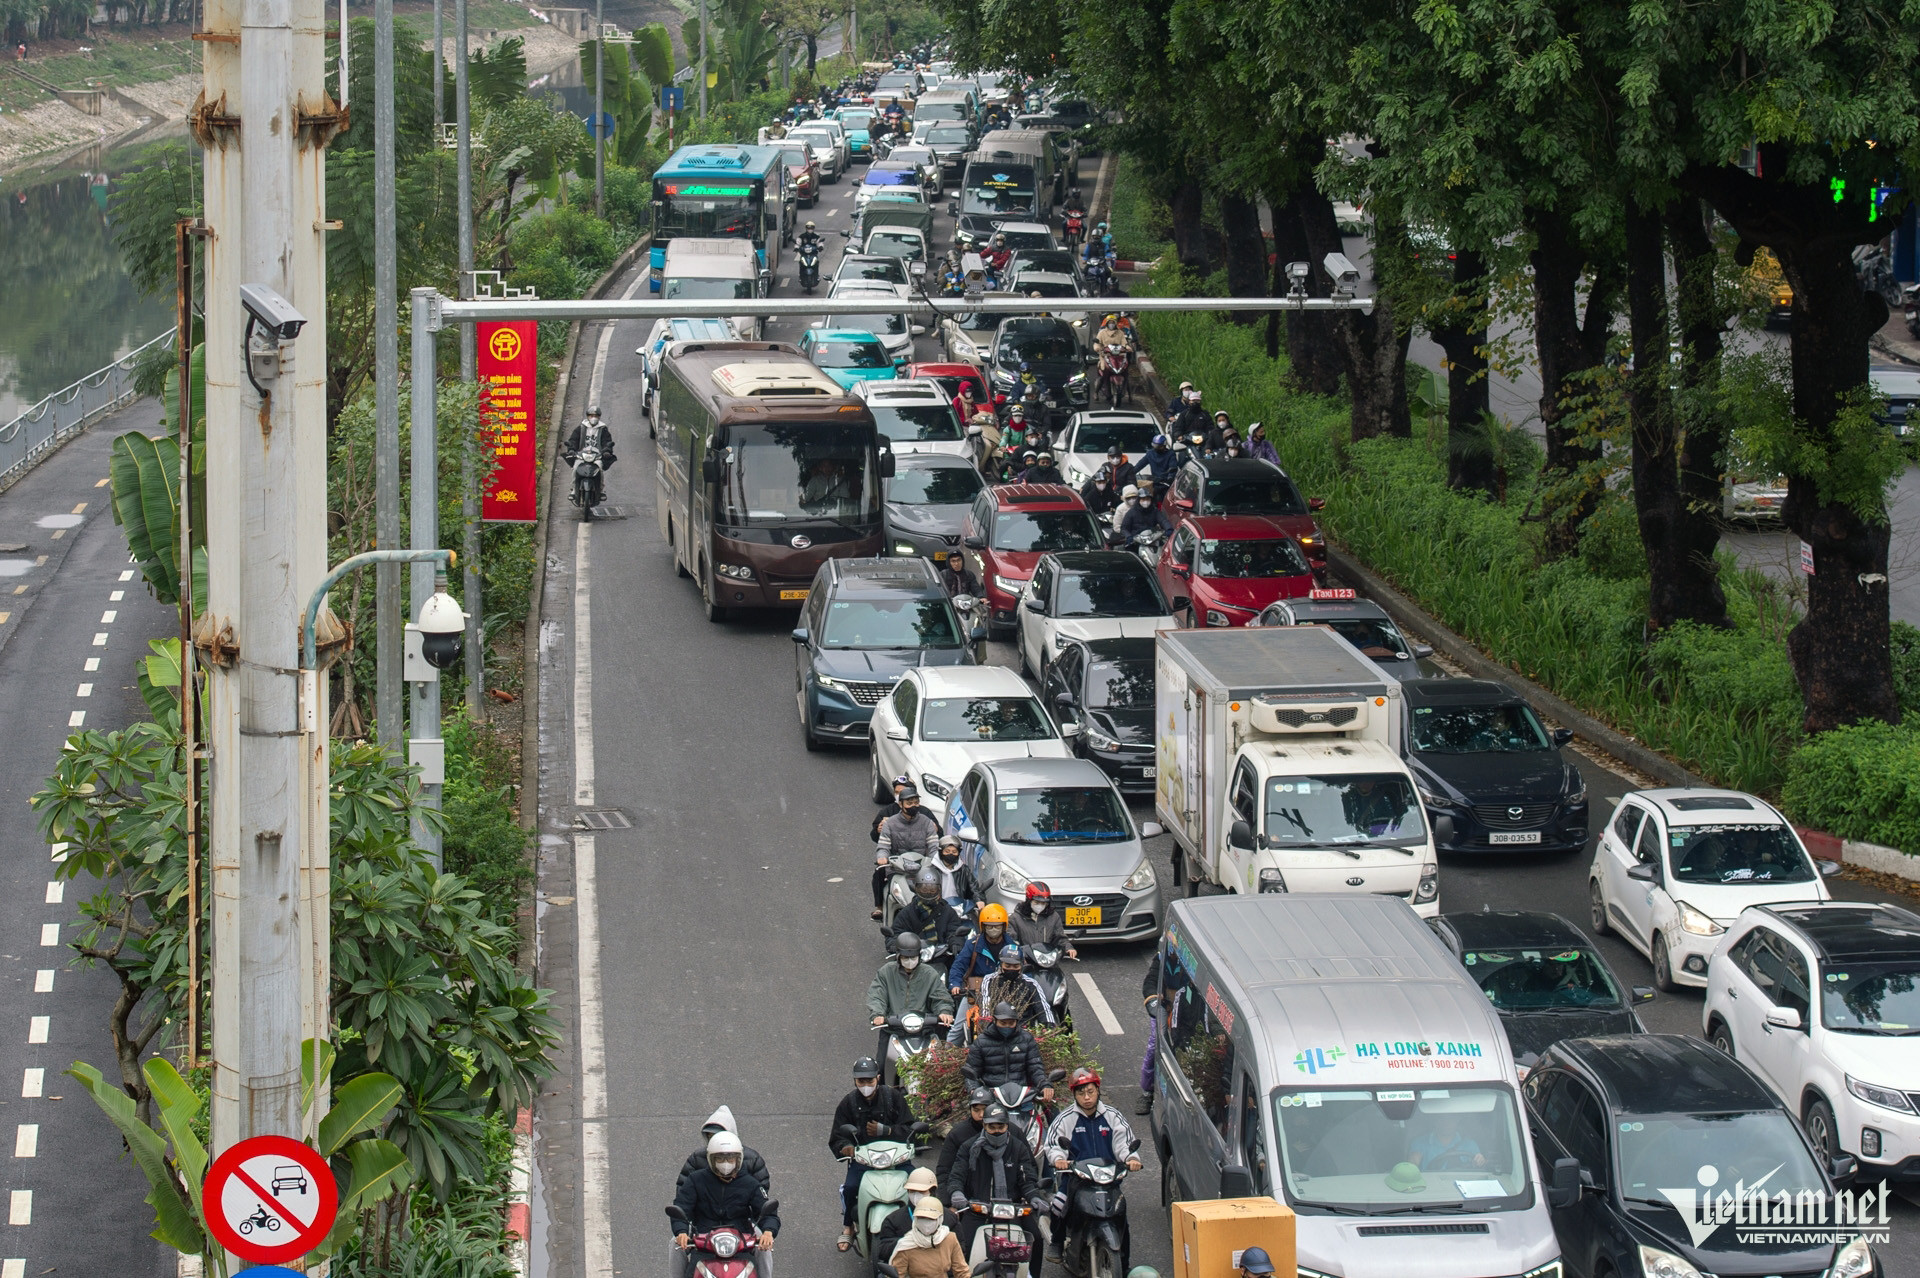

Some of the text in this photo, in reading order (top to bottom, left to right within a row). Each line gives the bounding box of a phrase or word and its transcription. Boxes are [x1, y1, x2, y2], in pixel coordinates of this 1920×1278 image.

[1315, 588, 1353, 598] Taxi 123
[1075, 908, 1091, 917] 30F
[1069, 916, 1097, 925] 219.21
[1355, 1040, 1482, 1060] HẠ LONG XANH
[1387, 1059, 1475, 1070] HOTLINE: 1900 2013
